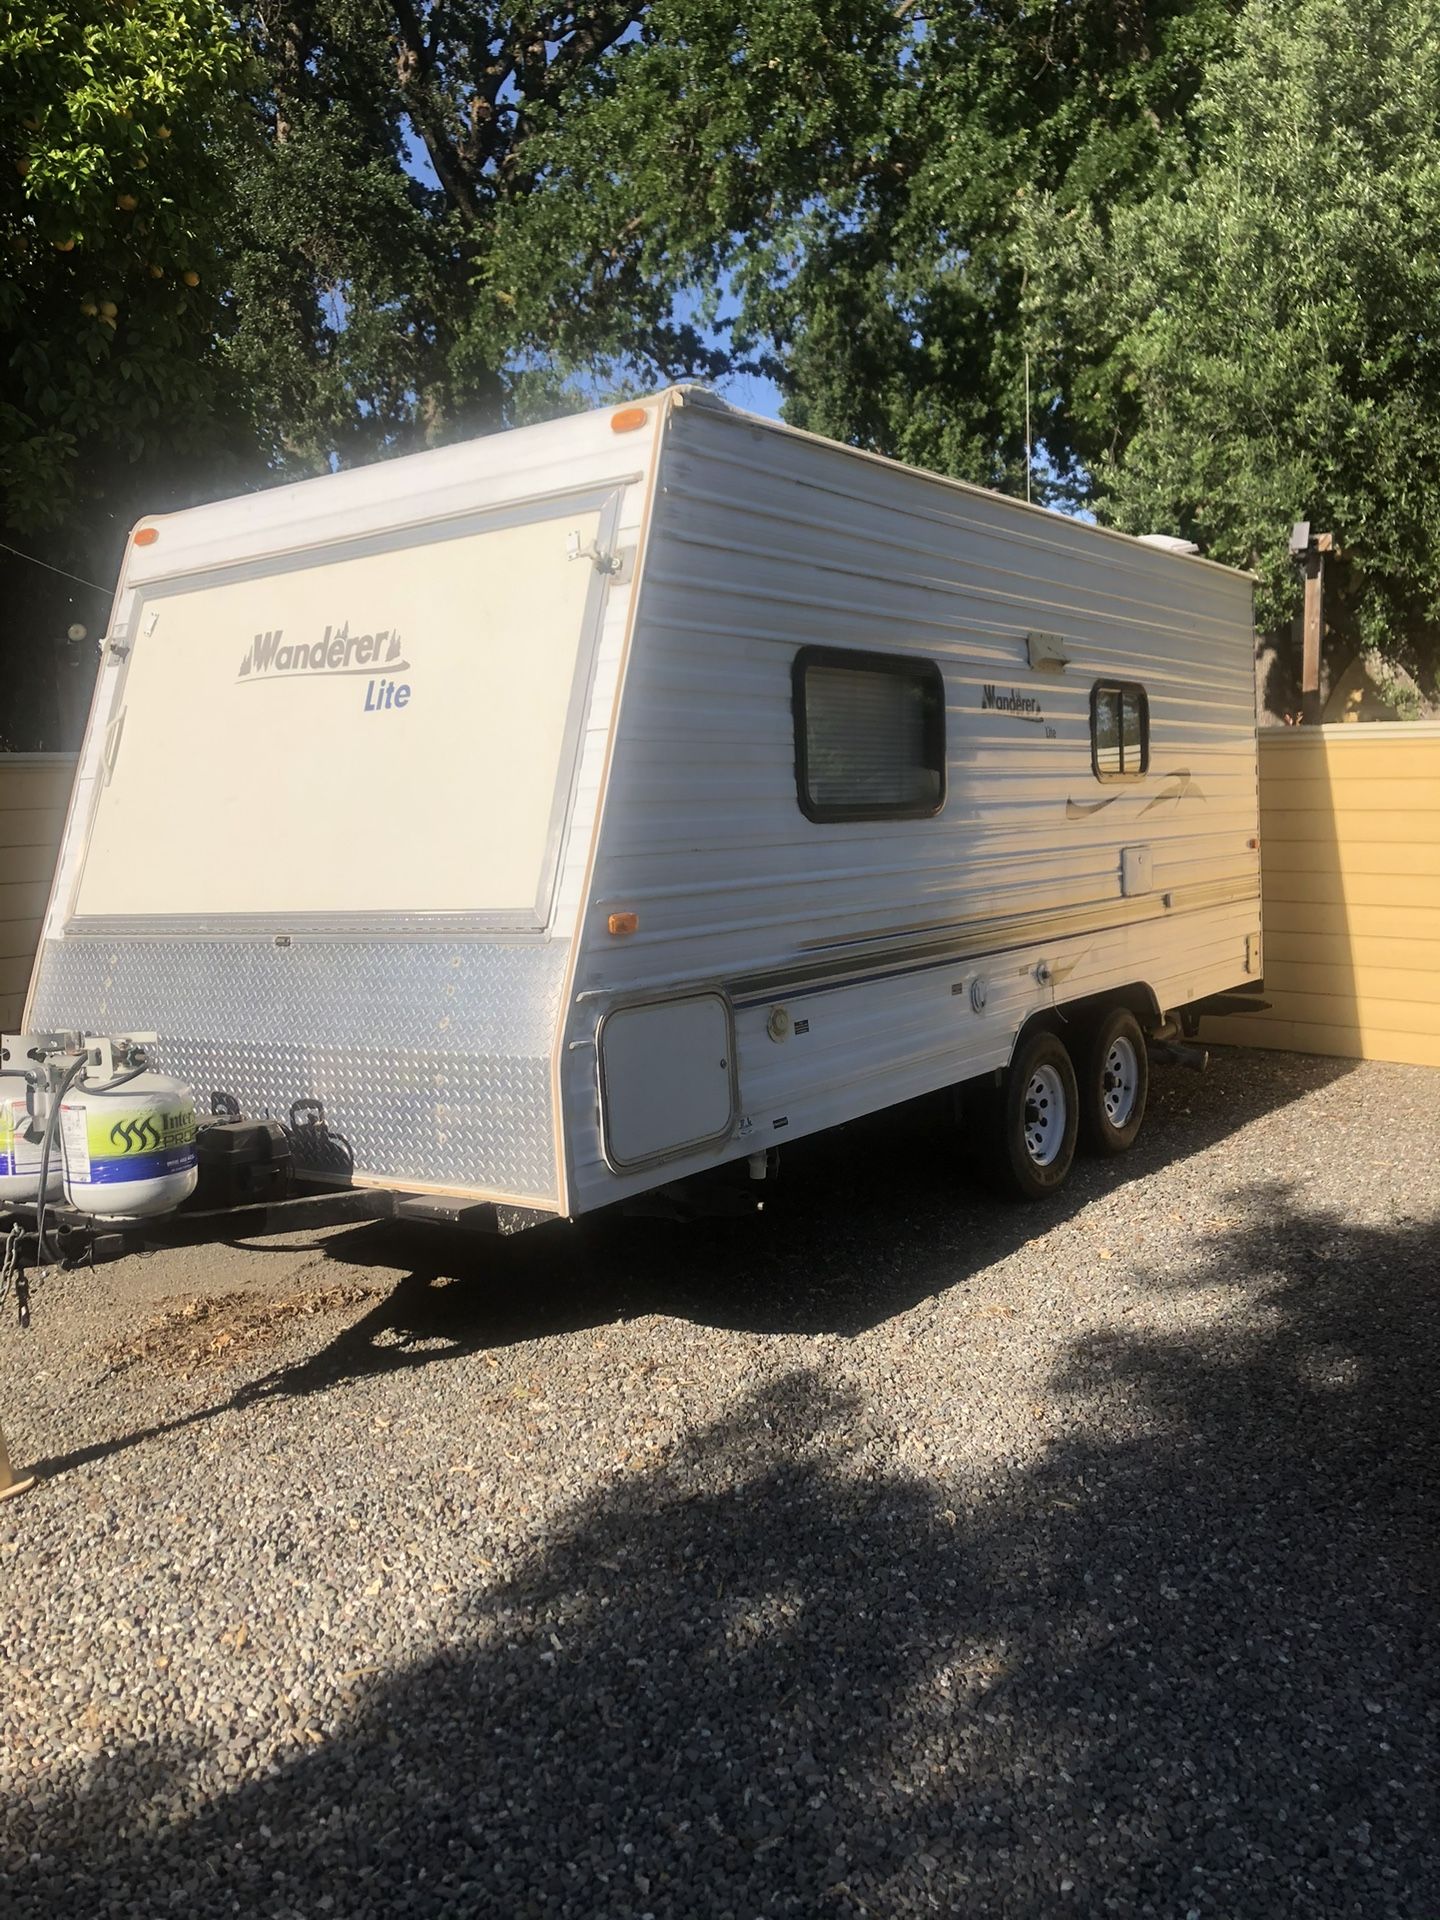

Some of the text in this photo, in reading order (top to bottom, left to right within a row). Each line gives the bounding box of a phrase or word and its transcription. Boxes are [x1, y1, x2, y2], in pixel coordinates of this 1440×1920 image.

[250, 624, 391, 674] Wanderer
[364, 679, 411, 712] Lite
[983, 684, 1037, 713] Wanderer
